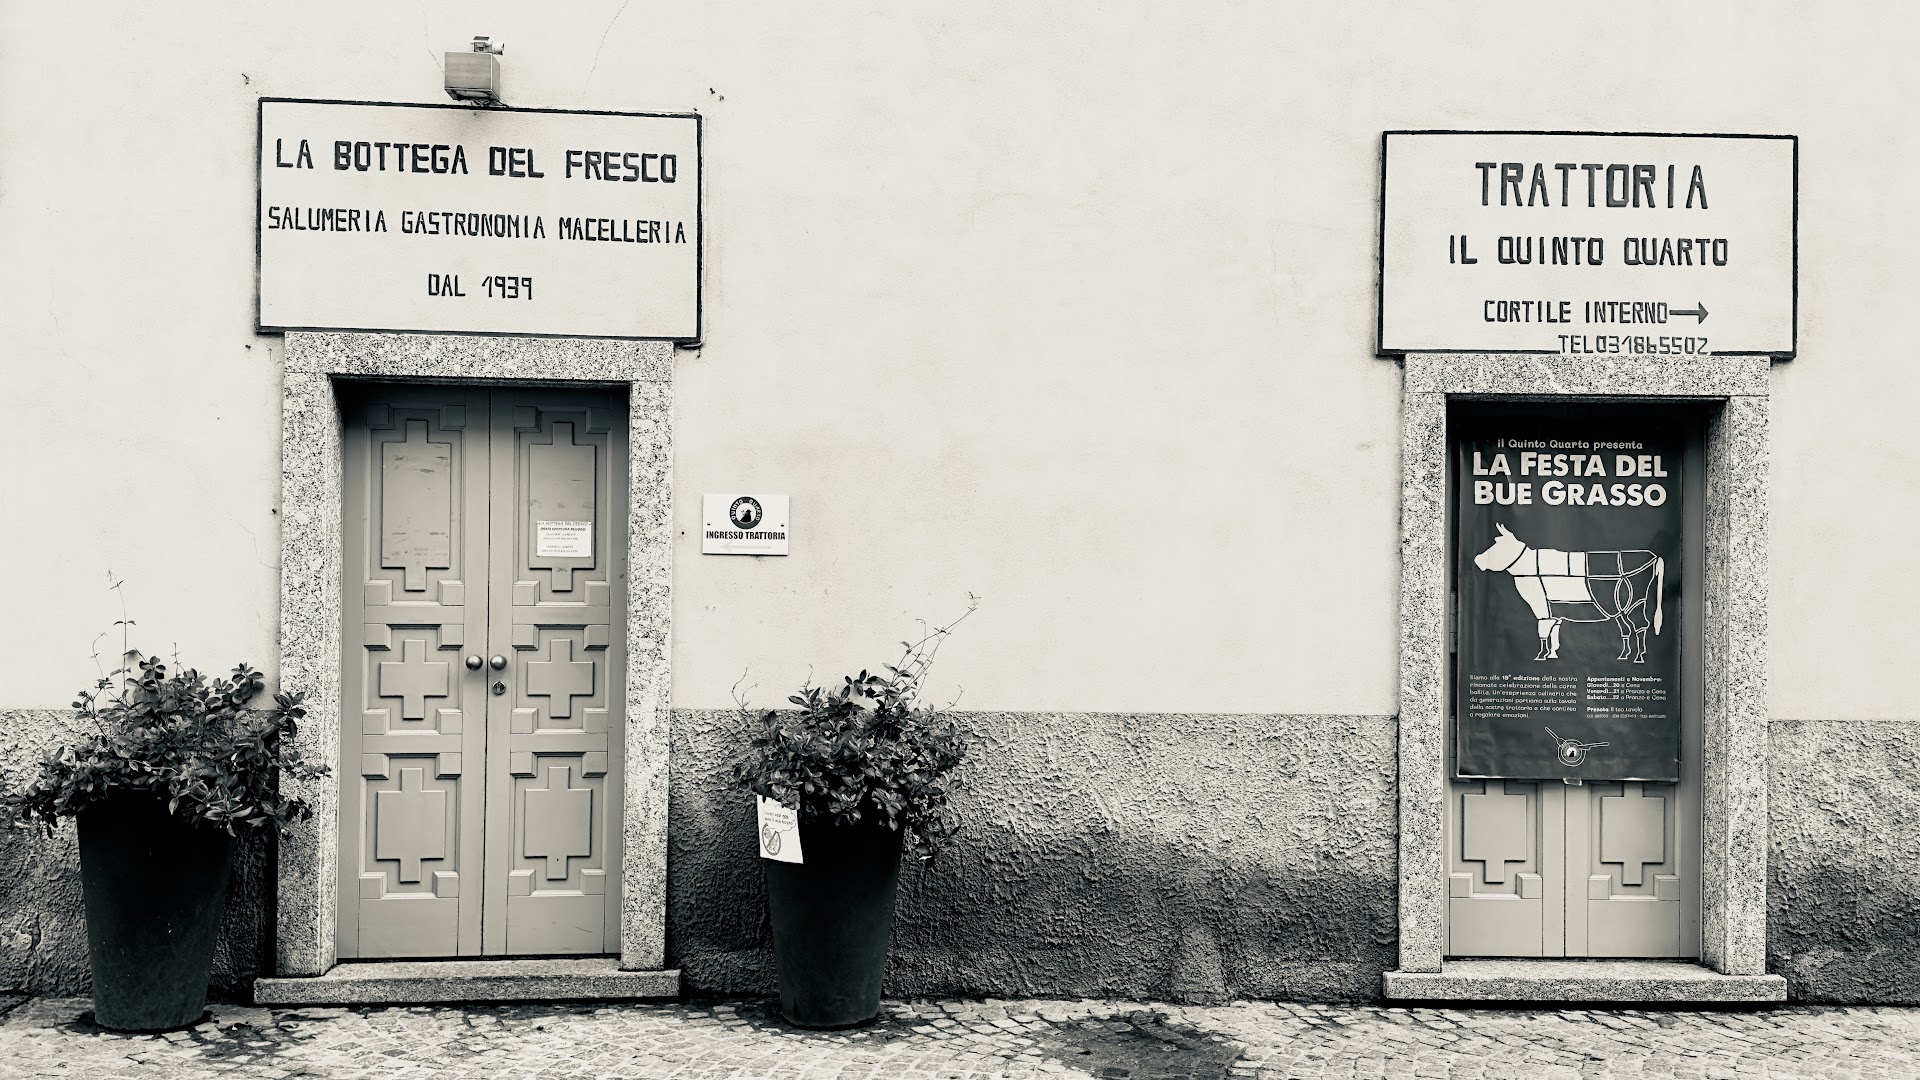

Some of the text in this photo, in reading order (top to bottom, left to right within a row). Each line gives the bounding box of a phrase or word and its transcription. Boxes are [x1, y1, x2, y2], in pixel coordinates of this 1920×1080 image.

[277, 139, 677, 183] LA BOTTEGA DEL FRESCO
[1475, 162, 1708, 209] TRATTORIA
[268, 206, 687, 244] SALUMERIA GASTRONOMIA MACELLERIA
[1450, 235, 1728, 266] IL QUINTO QUARTO
[428, 274, 532, 300] DAL 1939
[1484, 300, 1667, 324] CORTILE INTERNO
[1497, 438, 1643, 451] il Quinto Quarto presenta
[1473, 452, 1667, 477] LA FESTA DEL
[1475, 480, 1667, 507] BUE GRASSO
[706, 531, 786, 540] INGRESSO TRATTORIA
